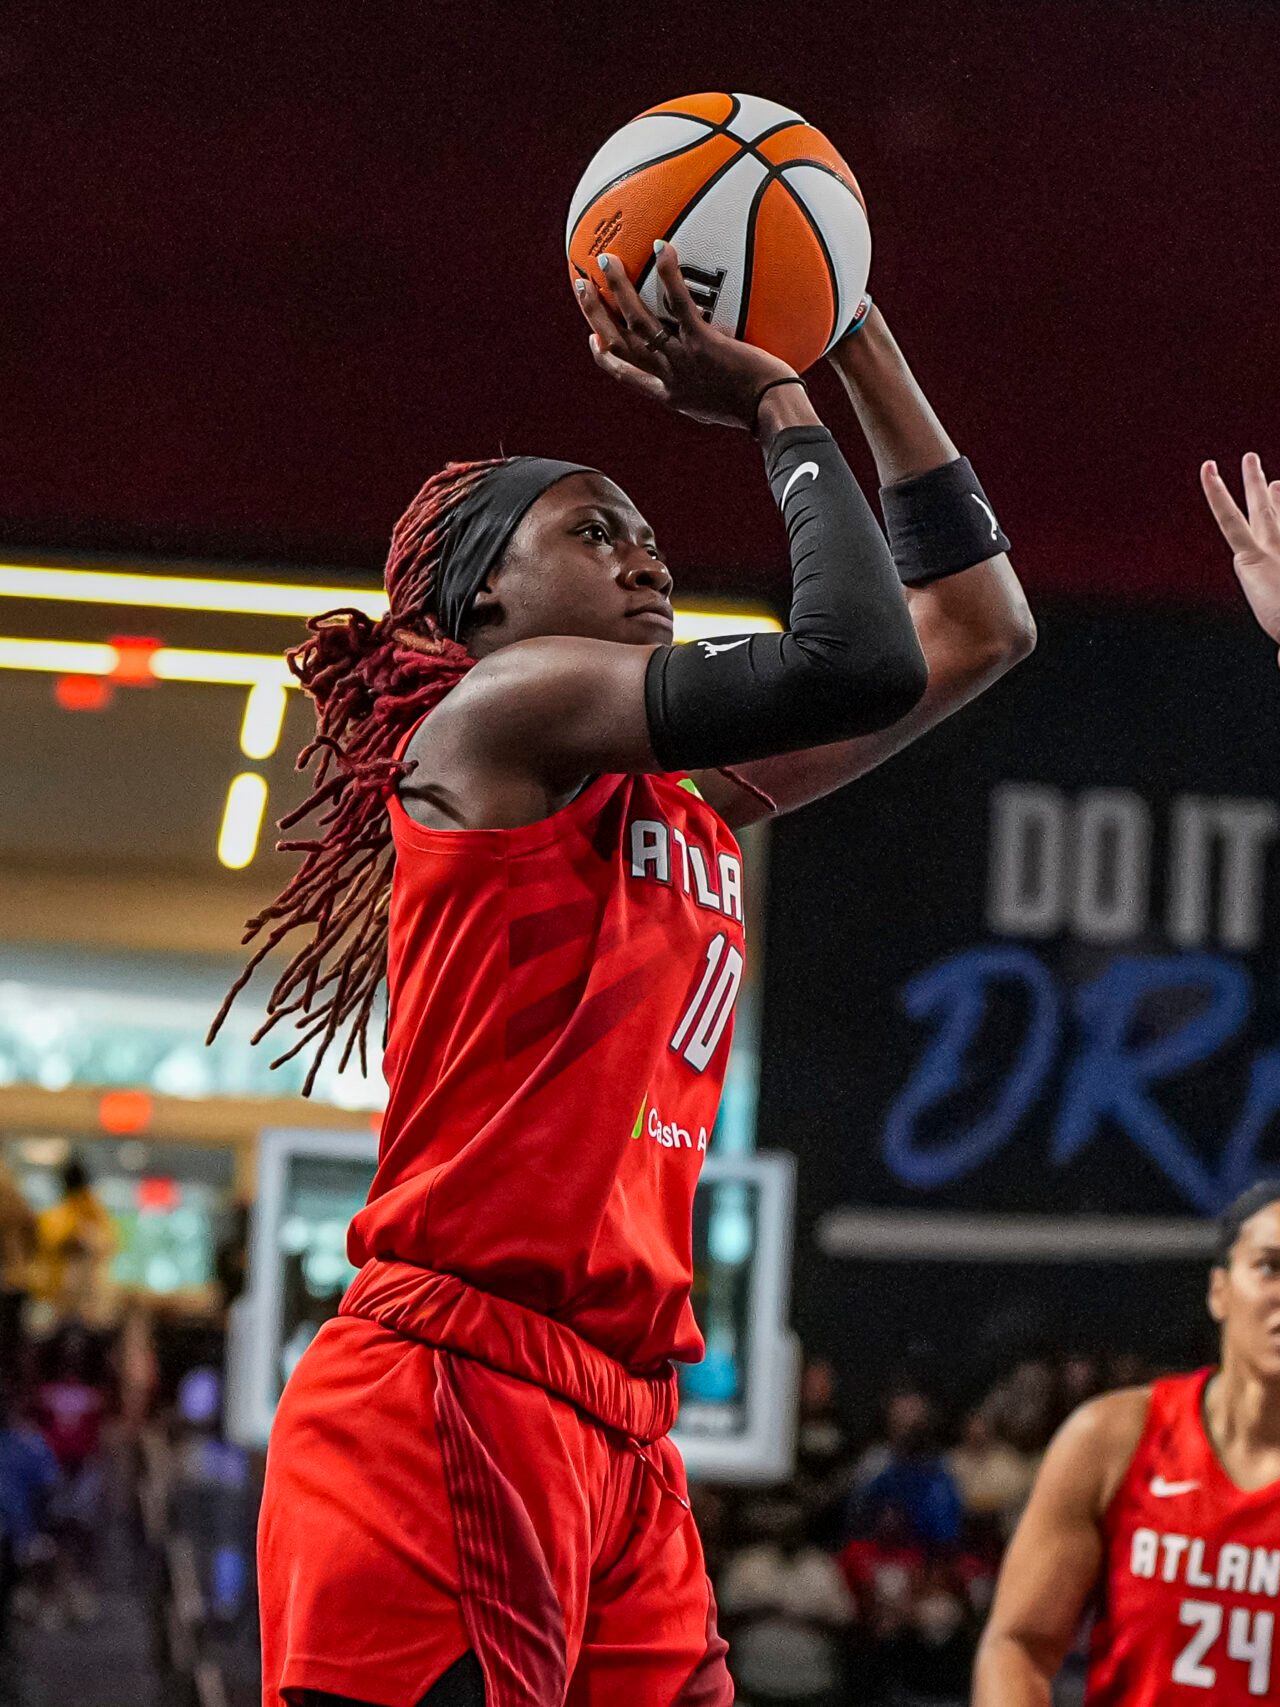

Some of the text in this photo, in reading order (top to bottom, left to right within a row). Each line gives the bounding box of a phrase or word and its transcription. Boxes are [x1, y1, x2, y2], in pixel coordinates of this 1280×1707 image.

[631, 820, 745, 938] ATLA
[990, 783, 1152, 943] DO
[669, 932, 743, 1073] 10
[648, 1107, 692, 1148] Cash
[1172, 1599, 1274, 1695] 24
